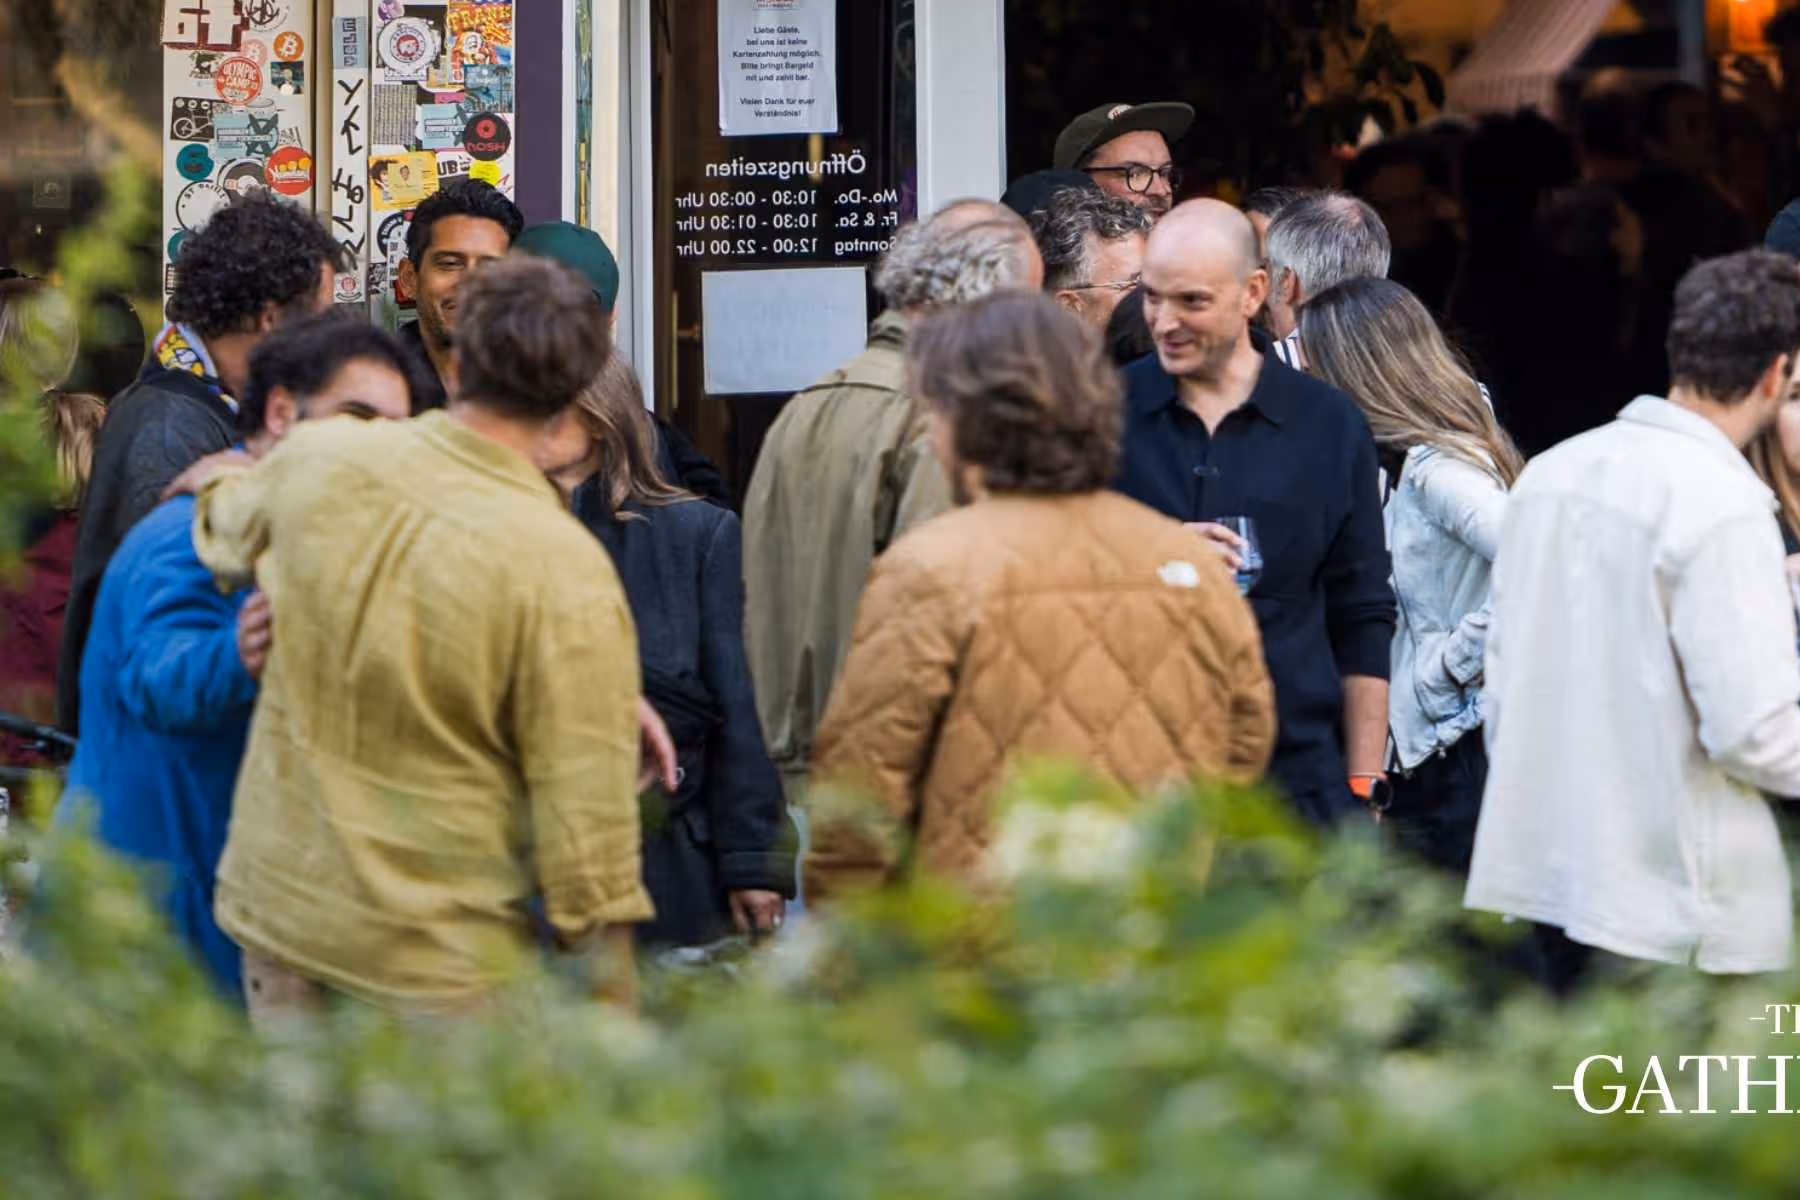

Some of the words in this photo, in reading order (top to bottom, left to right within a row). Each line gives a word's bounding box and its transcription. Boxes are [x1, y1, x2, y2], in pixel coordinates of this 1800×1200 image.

[753, 26, 775, 34] Liebe
[745, 38, 759, 46] bei
[788, 37, 808, 45] keine
[732, 50, 788, 59] Kartenzahlung
[789, 50, 822, 59] möglich.
[740, 62, 758, 70] Bitte
[760, 62, 783, 71] bringt
[784, 61, 815, 71] Bargeld
[775, 73, 794, 81] zahlt
[740, 97, 763, 105] Vielen
[764, 97, 785, 105] Dank
[786, 96, 797, 105] für
